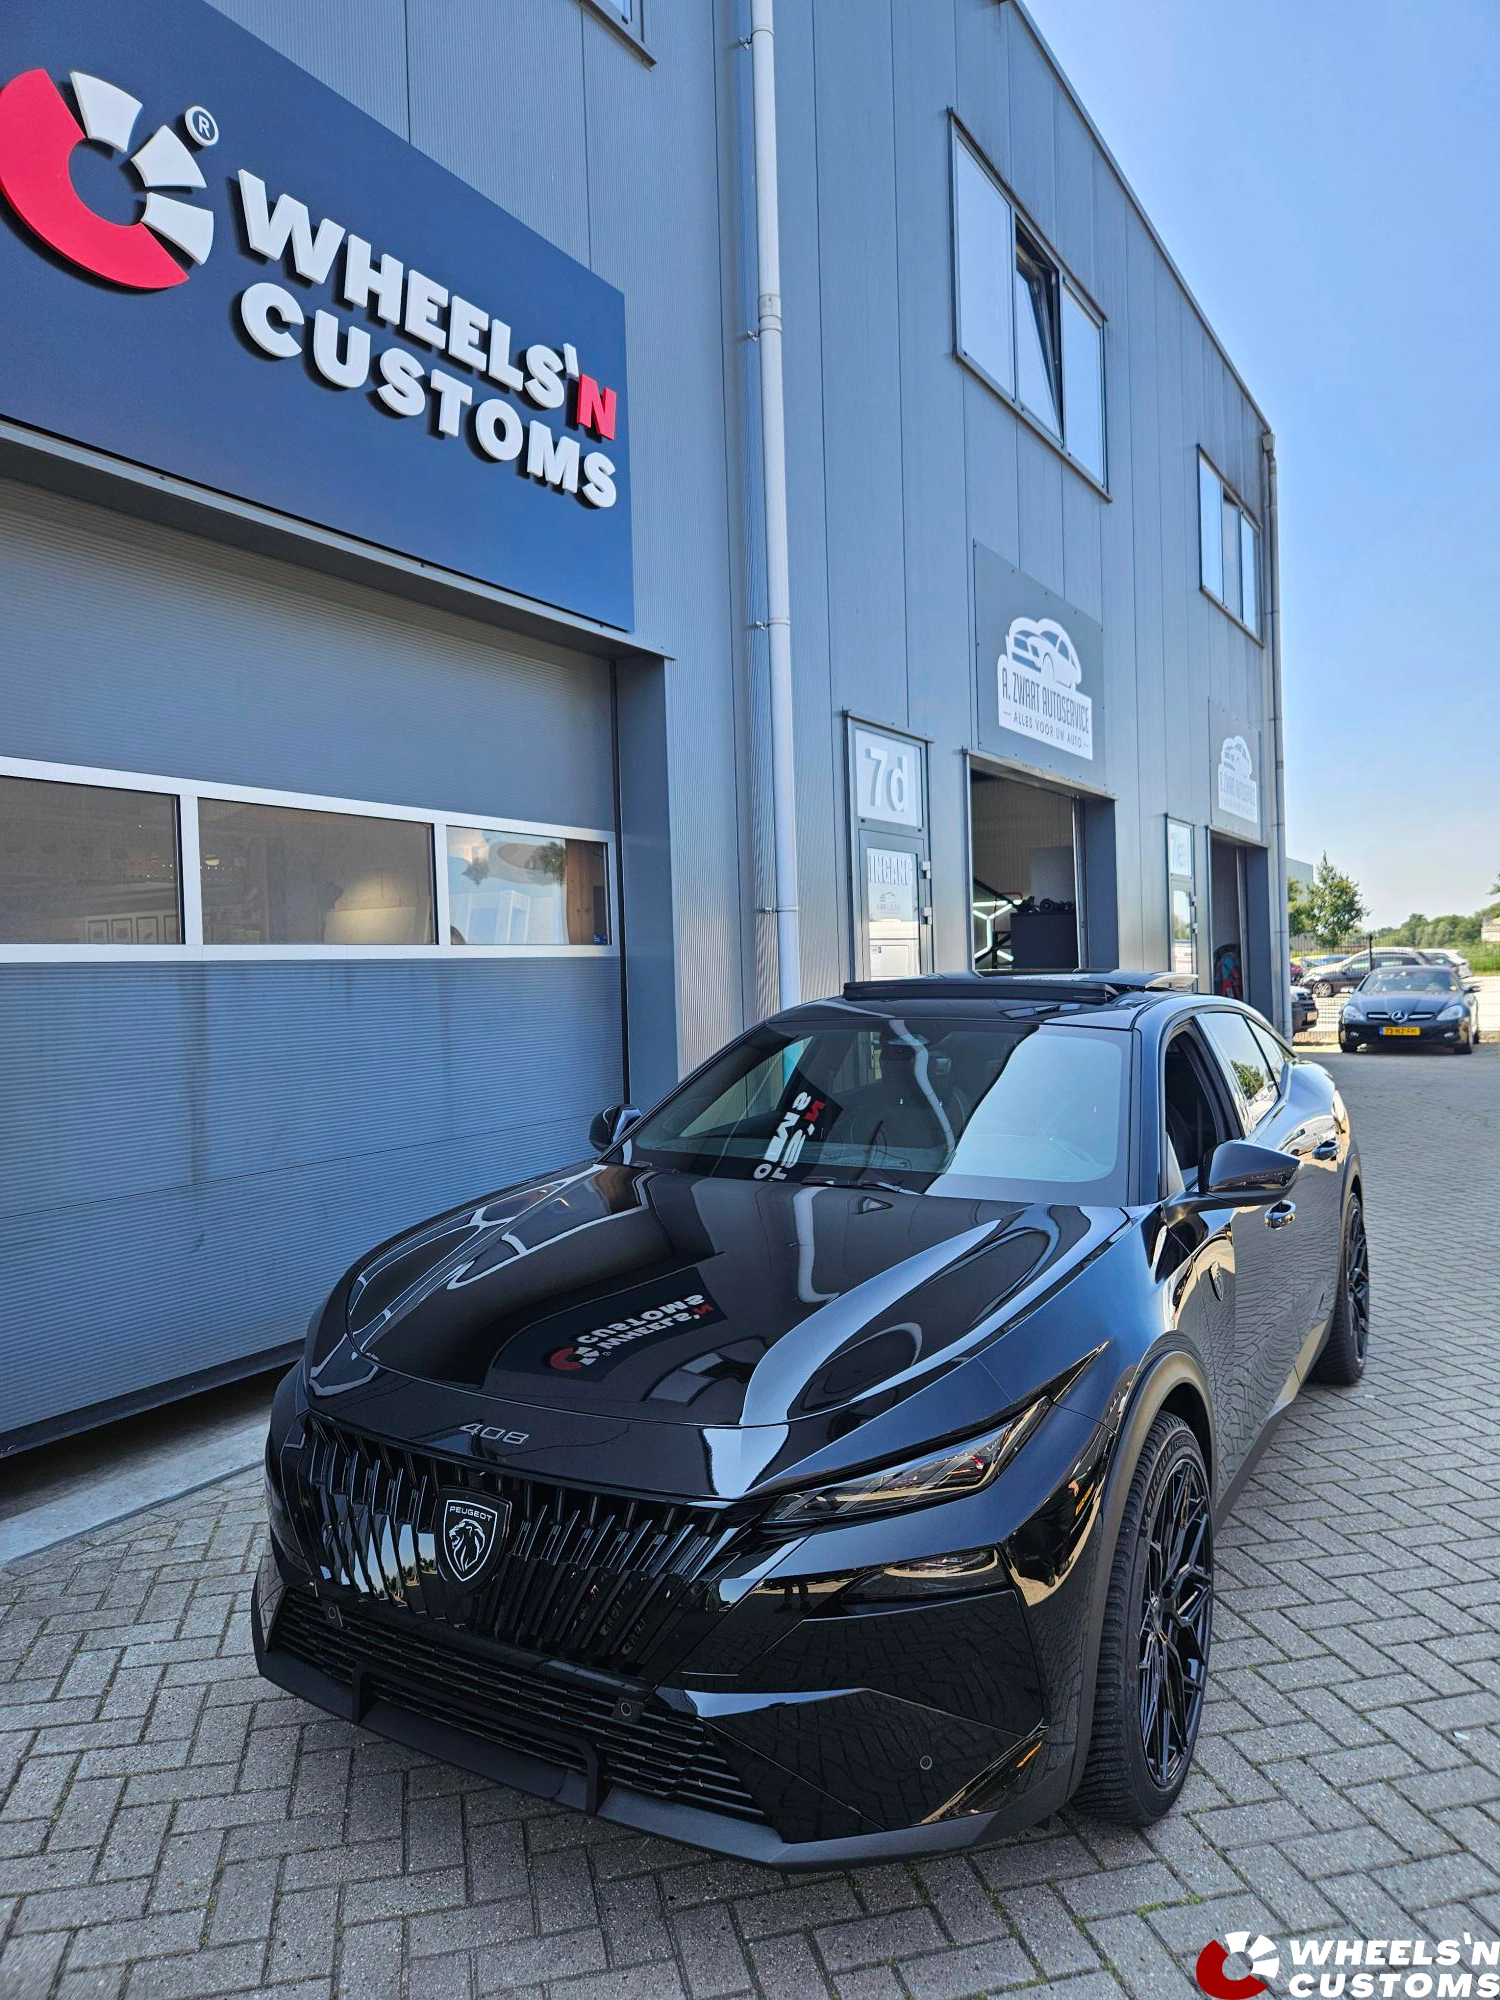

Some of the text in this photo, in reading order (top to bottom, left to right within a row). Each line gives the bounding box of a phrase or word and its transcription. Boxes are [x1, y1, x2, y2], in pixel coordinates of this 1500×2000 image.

[238, 168, 618, 441] WHEELS'N
[240, 282, 618, 509] CUSTOMS
[1002, 667, 1089, 734] A. ZWART AUTOSERVICE
[1013, 711, 1033, 729] ALLES
[1035, 719, 1054, 736] VOOR
[1067, 733, 1082, 749] AUTO
[866, 747, 908, 813] 7d
[460, 1423, 530, 1445] 408
[449, 1505, 493, 1522] PEUGEOT
